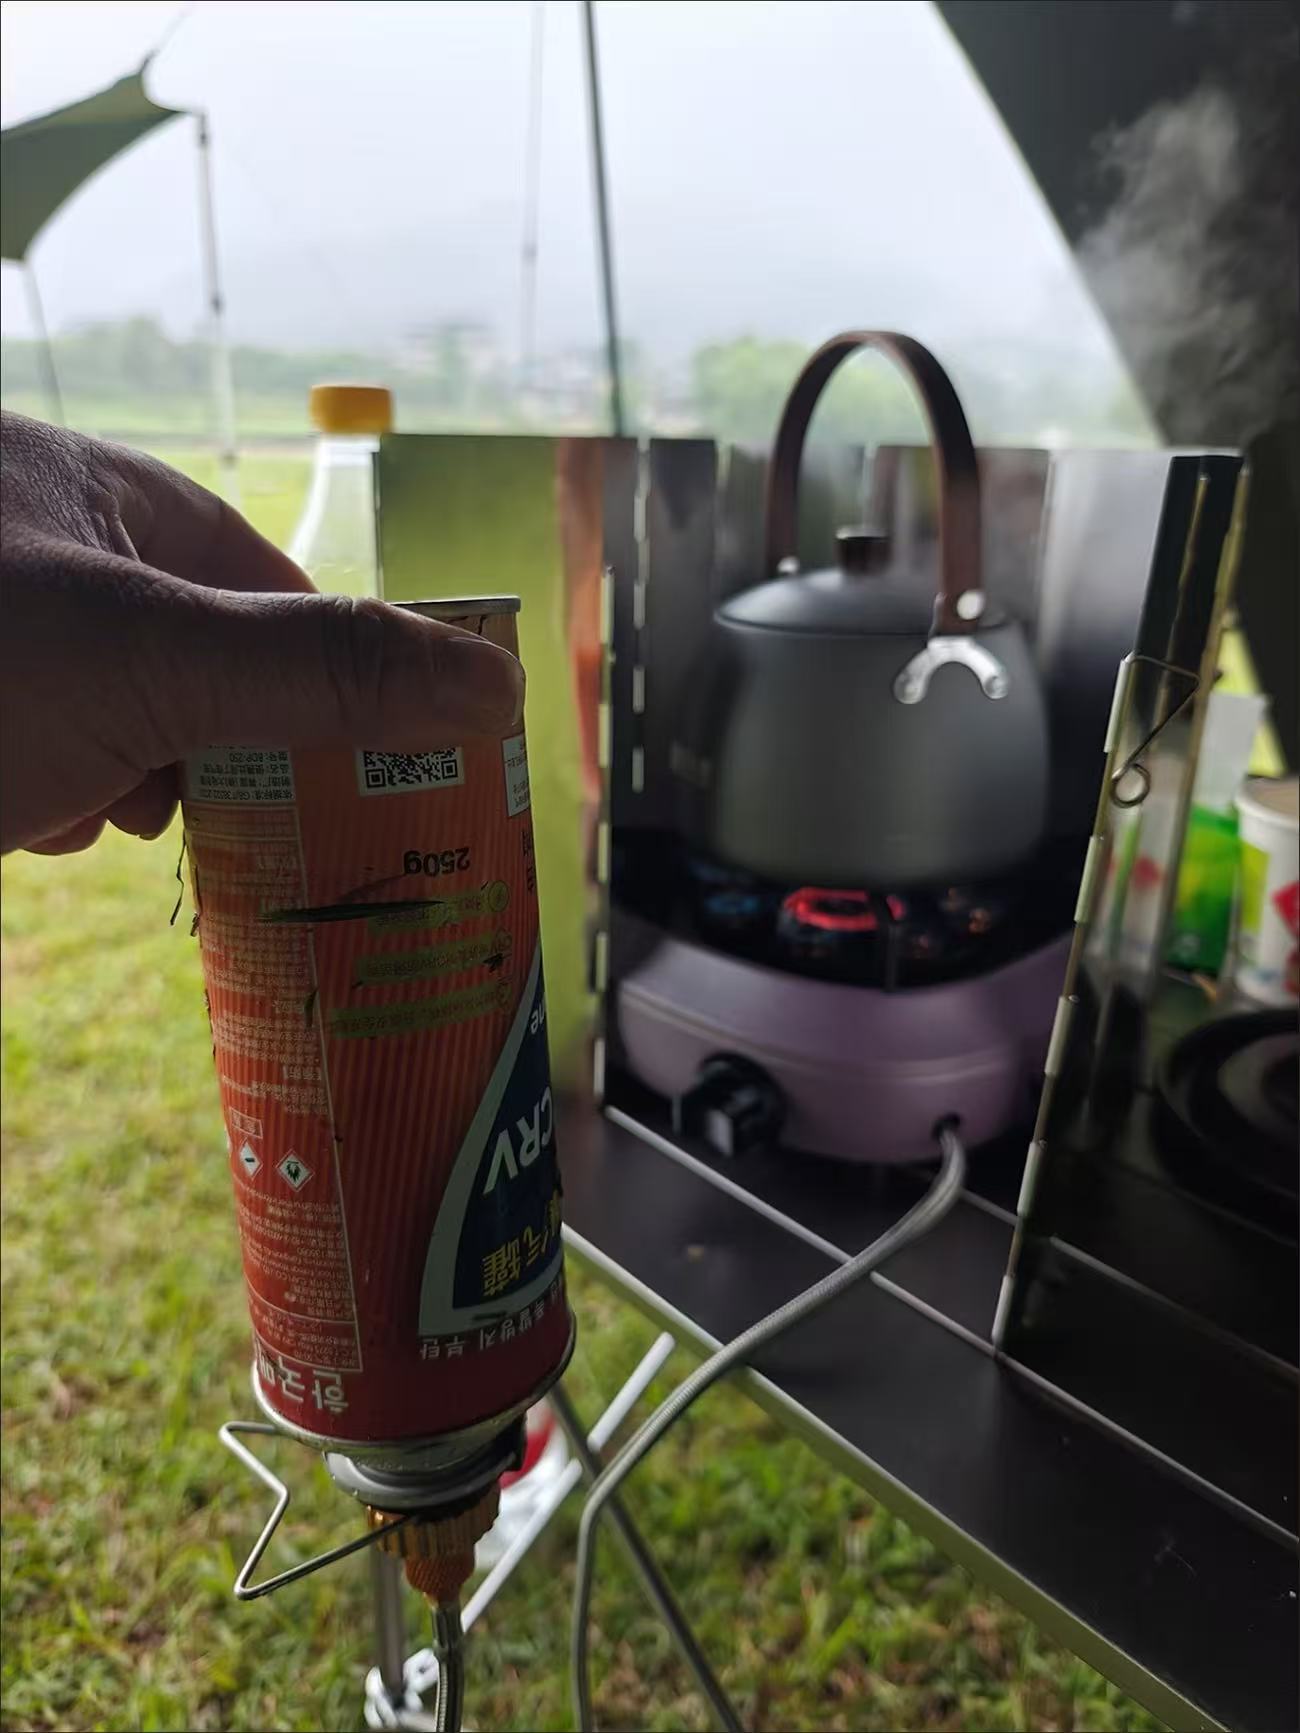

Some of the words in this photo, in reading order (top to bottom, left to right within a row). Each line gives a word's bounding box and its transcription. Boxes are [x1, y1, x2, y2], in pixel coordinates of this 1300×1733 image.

[404, 847, 470, 877] 250g
[482, 1086, 553, 1196] CRV
[419, 1335, 467, 1361] 부탄
